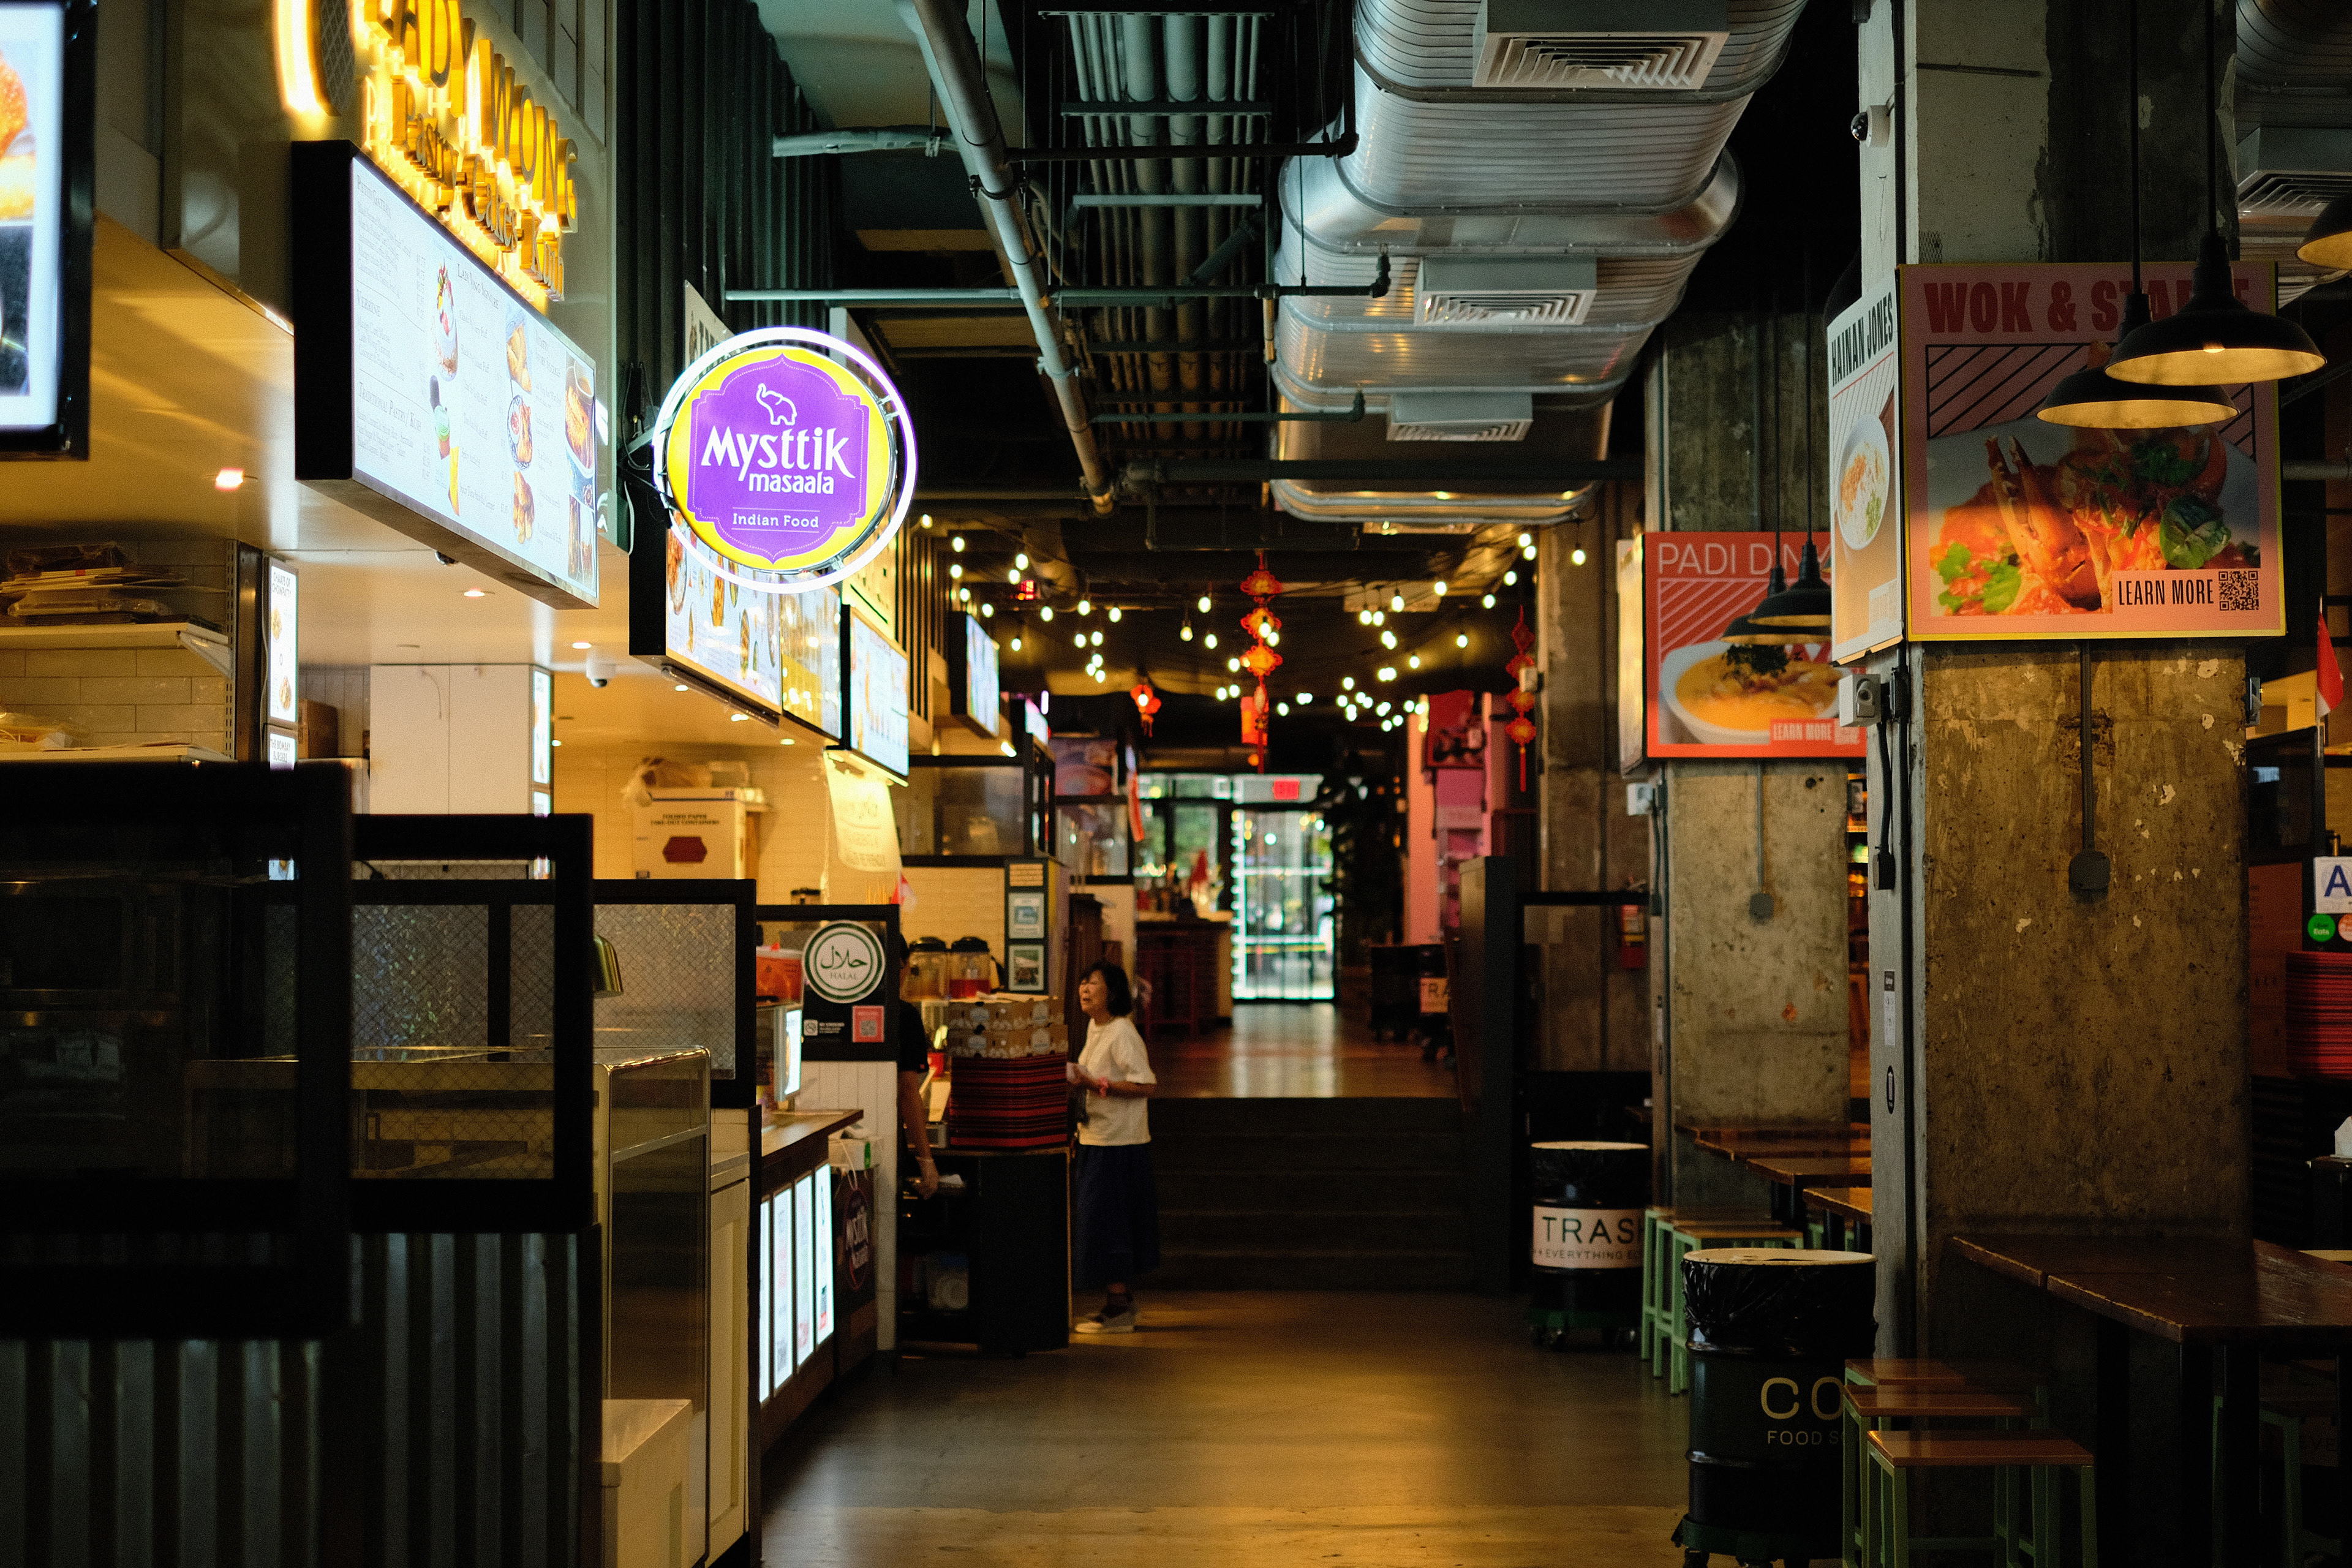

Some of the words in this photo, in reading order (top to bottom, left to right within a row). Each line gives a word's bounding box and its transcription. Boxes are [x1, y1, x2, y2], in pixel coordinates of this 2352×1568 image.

[478, 39, 578, 233] WONG
[1923, 281, 2033, 333] WOK
[2047, 281, 2077, 333] &
[1831, 316, 1864, 387] HAINAN
[1867, 292, 1893, 360] JONES
[701, 425, 856, 481] Mysttik
[748, 471, 834, 494] masaala
[733, 513, 779, 526] Indian
[783, 515, 819, 528] Food
[1659, 542, 1736, 575] PADI
[2119, 580, 2165, 606] LEARN
[2173, 579, 2214, 605] MORE
[1773, 723, 1803, 741] LEARN
[1806, 723, 1832, 741] MORE
[2323, 865, 2352, 897] A
[820, 945, 869, 970] حلال
[1545, 1248, 1623, 1260] EVERYTHING
[1767, 1430, 1823, 1446] FOOD
